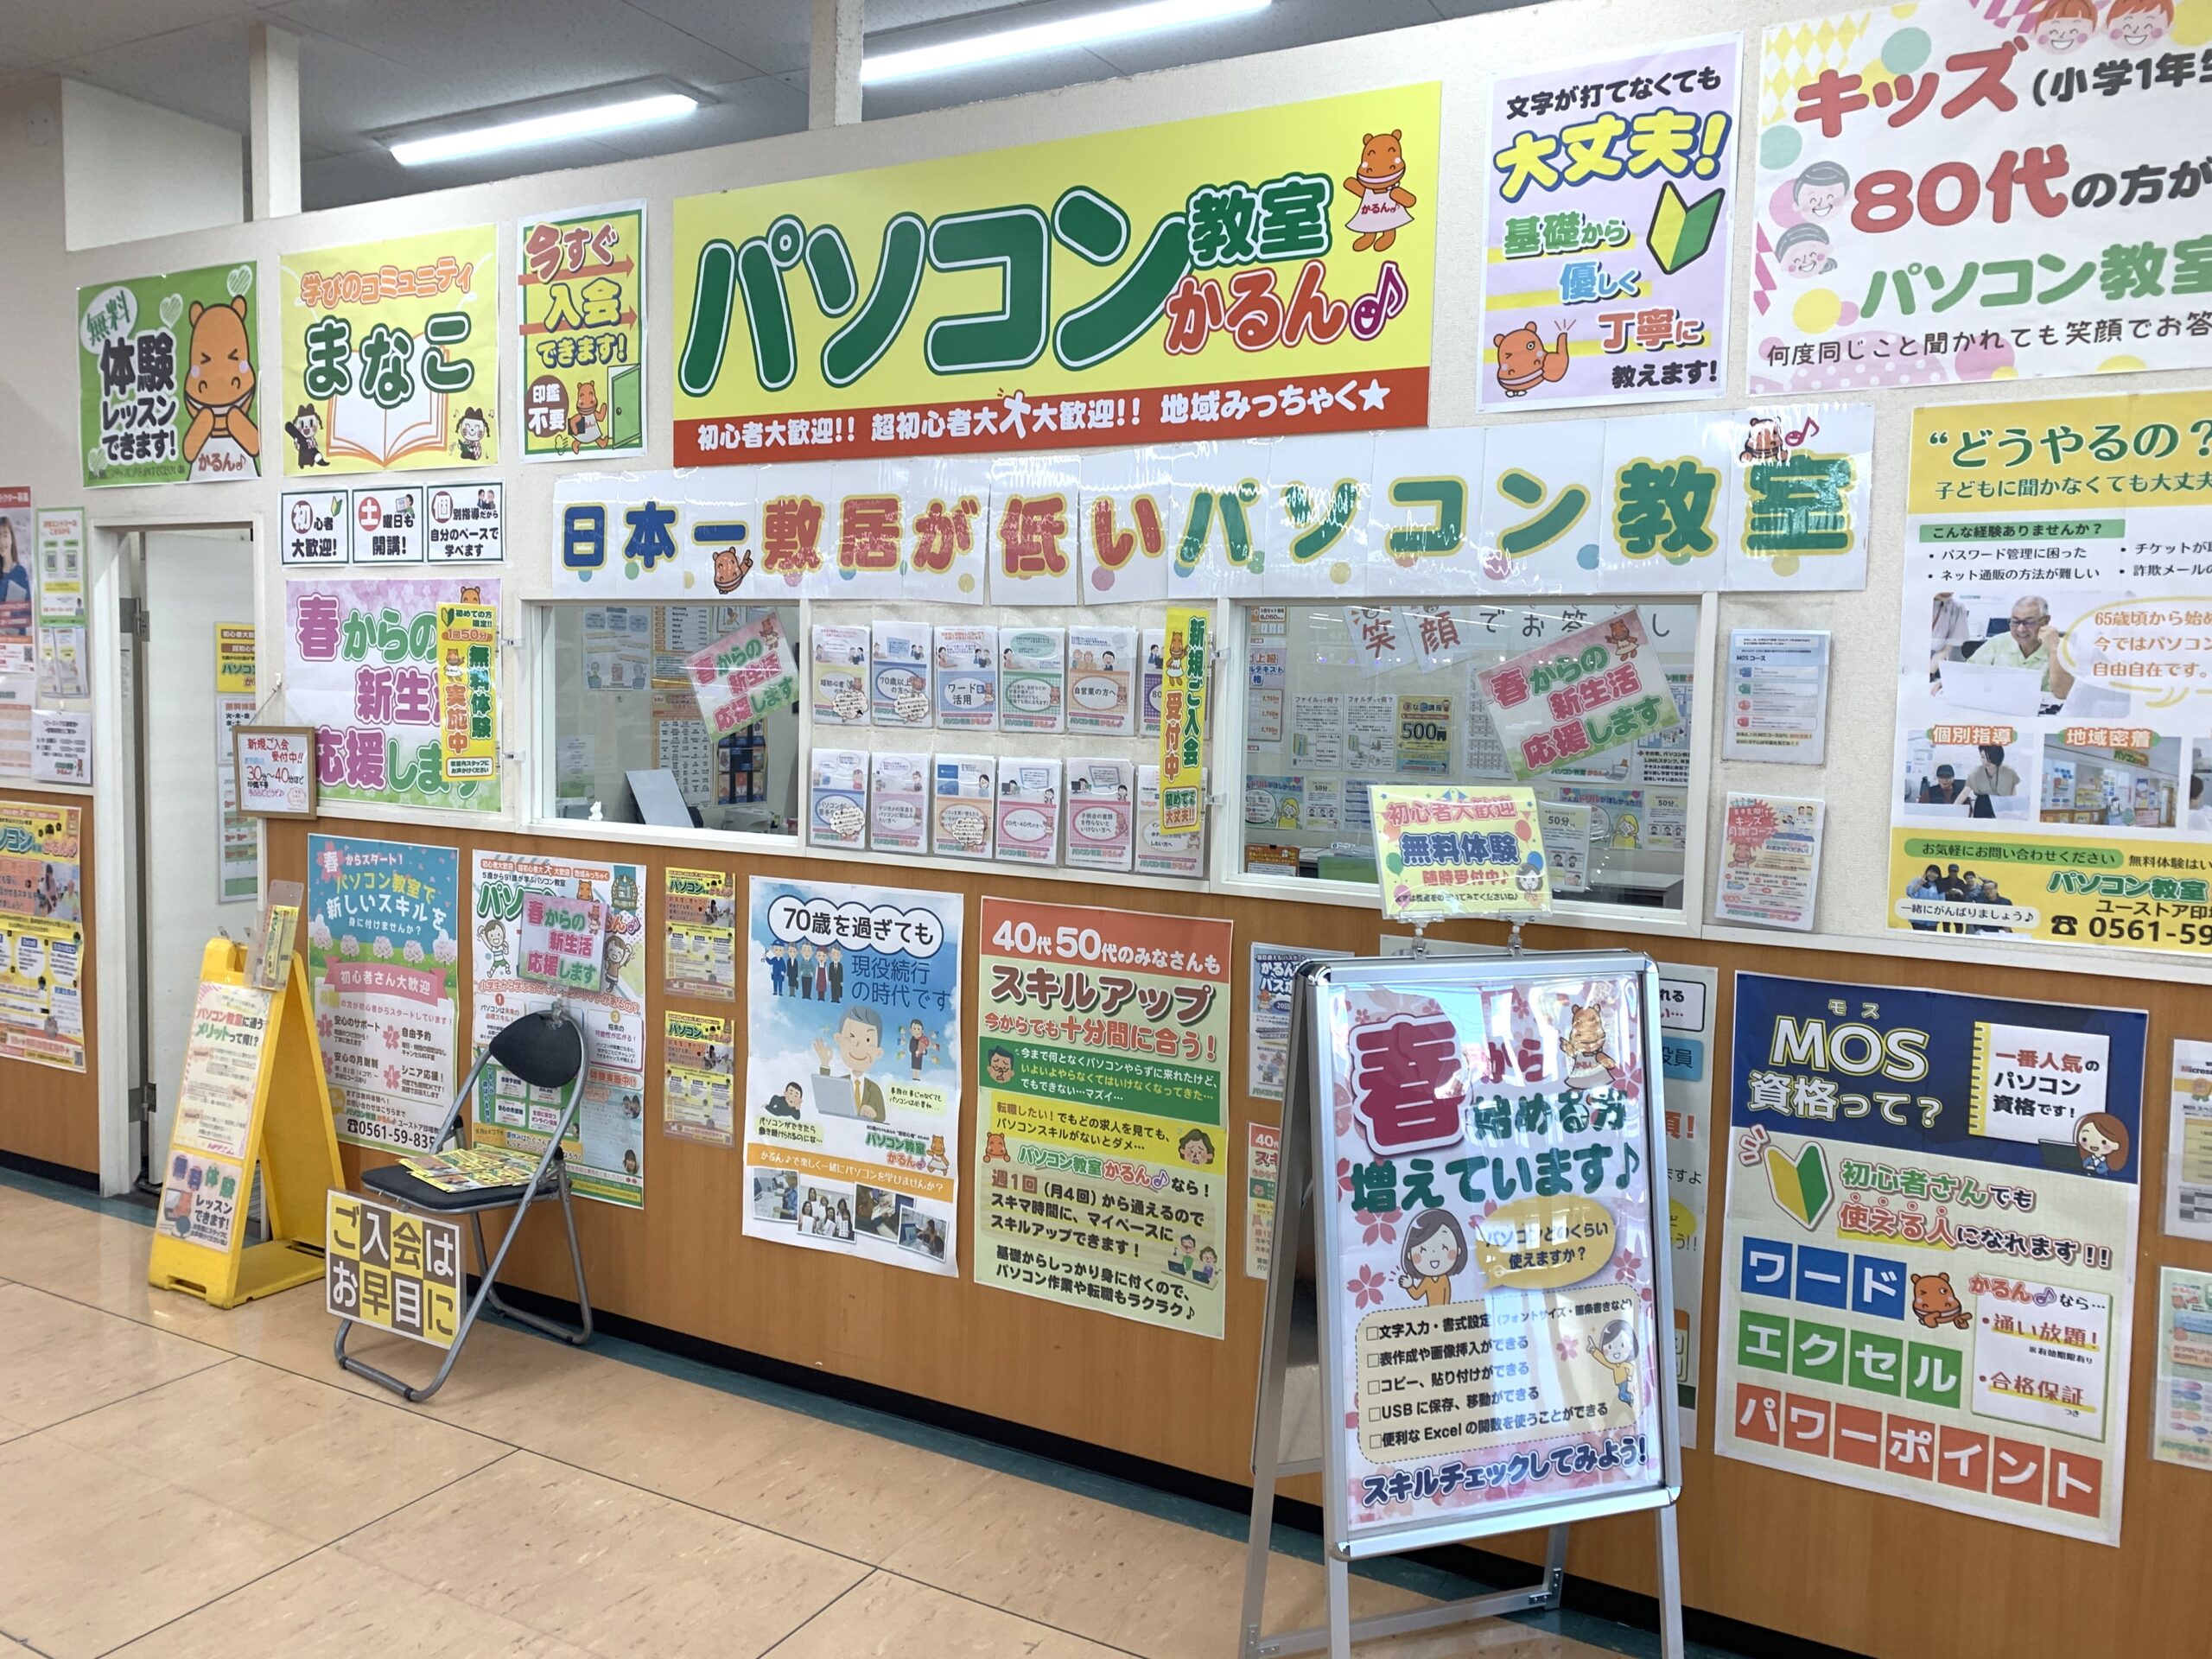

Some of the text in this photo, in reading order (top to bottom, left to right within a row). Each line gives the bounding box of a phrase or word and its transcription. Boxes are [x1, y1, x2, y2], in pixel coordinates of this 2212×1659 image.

[1506, 67, 1722, 120] 文字が打てなくても
[1794, 35, 2030, 137] キッズ
[1494, 106, 1732, 203] 大丈夫!
[1186, 172, 1333, 270] 教室
[1503, 210, 1630, 259] 基礎から
[525, 223, 619, 283] 今すぐ
[301, 257, 474, 308] 学びのコミュニティ
[678, 184, 1192, 398] パソコン
[1560, 261, 1643, 304] 優しく
[1860, 233, 2212, 318] パソコン教室
[87, 290, 130, 346] 無料
[543, 277, 622, 333] 入会
[1598, 308, 1705, 353] 丁寧に
[101, 333, 175, 397] 体験
[304, 313, 474, 409] まなこ
[537, 333, 628, 369] できます!
[1611, 359, 1718, 390] 教えます!
[532, 383, 561, 403] 印鑑
[103, 396, 176, 430] レッスン
[528, 407, 566, 435] 不要
[102, 429, 176, 461] できます!
[698, 416, 855, 452] 初心者大歓迎!!
[292, 503, 334, 531] 初心者
[359, 499, 414, 529] 土曜日も
[434, 493, 499, 521] 個別指導だから
[372, 537, 407, 556] 開講!
[430, 527, 499, 542] 自分のペースで
[1933, 523, 2102, 539] こんな経験ありませんか？
[292, 538, 337, 558] 大歓迎!
[445, 543, 484, 557] 学べます
[1942, 547, 2088, 561] パスワード管理に困った
[1941, 568, 2100, 582] ネット通販の方法が難しい
[455, 609, 493, 619] 初めての方
[447, 629, 488, 641] 1回50分
[694, 638, 764, 685] 春からの
[728, 651, 782, 696] 新生活
[1490, 645, 1610, 709] 春からの
[2094, 661, 2208, 678] 自由自在です。
[948, 683, 976, 693] ワード
[953, 694, 972, 705] 活用
[1074, 686, 1116, 696] 自営業の方へ
[1182, 617, 1207, 768] 新規ご入会
[1548, 663, 1642, 721] 新生活
[444, 683, 469, 755] 実施中
[714, 677, 794, 733] 応援します
[247, 738, 289, 751] 新規ご入会
[1164, 690, 1183, 782] 受付中
[1522, 695, 1663, 770] 応援します
[1933, 725, 2014, 746] 個別指導
[2065, 728, 2152, 748] 地域密着
[1388, 797, 1517, 826] 初心者大歓迎
[1399, 832, 1521, 866] 無料体験
[1922, 842, 2116, 866] お気軽にお問い合わせください
[335, 872, 435, 905] パソコン教室で
[2047, 870, 2209, 903] パソコン教室
[326, 895, 448, 931] 新しいスキルを
[348, 918, 422, 936] 身に付けませんか？
[528, 899, 586, 931] 春からの
[783, 907, 933, 945] 70歳を過ぎても
[549, 930, 594, 957] 新生活
[993, 920, 1220, 975] 40代 50代のみなさんも
[340, 969, 430, 995] 初心者さん大歓迎
[527, 951, 597, 984] 応援します
[851, 955, 930, 984] 現役続行
[851, 982, 950, 1012] の時代です
[990, 964, 1216, 1026] スキルアップ
[1828, 998, 1881, 1019] モス
[334, 1015, 380, 1033] 安心のサポート
[402, 1027, 431, 1042] 自由予約
[984, 1012, 1216, 1061] 今からでも十分間に合う！
[334, 1052, 378, 1069] 安心の月謝制
[1769, 1015, 1930, 1082] MOS
[1996, 1050, 2100, 1073] 一番人気の
[1021, 1047, 1217, 1089] 今まで何となくパソコンやらずに来れたけど、
[1994, 1071, 2081, 1096] パソコン
[1748, 1070, 1942, 1128] 資格って？
[1993, 1094, 2075, 1118] 資格です!
[759, 1117, 816, 1134] パソコンができたら
[865, 1132, 926, 1157] パソコン教室
[1018, 1146, 1104, 1178] パソコン教室
[1840, 1159, 2035, 1211] 初心者さんでも
[196, 1194, 232, 1215] レッスン
[991, 1193, 1174, 1243] スキマ時間に、マイペースに
[334, 1206, 454, 1277] ご入会は
[991, 1214, 1140, 1257] スキルアップできます！
[1837, 1202, 2112, 1268] 使える人になれます!!
[996, 1244, 1190, 1301] 基礎からしっかり身に付くので、
[1509, 1248, 1586, 1269] 使えますか？
[1749, 1249, 1897, 1305] ワード
[333, 1261, 454, 1336] お早目に
[1993, 1313, 2098, 1349] 通い放題！
[1379, 1335, 1529, 1367] 表作成や画像挿入ができる
[1745, 1323, 1957, 1394] エクセル
[1380, 1362, 1529, 1393] コピー、貼り付けができる
[1991, 1370, 2084, 1407] 合格保証
[1382, 1387, 1540, 1420] USB に保存、移動ができる
[2064, 1408, 2080, 1418] つき
[1382, 1402, 1609, 1448] 便利な Excel の関数を使うことができる
[1739, 1396, 2093, 1499] パワーポイント
[1361, 1434, 1648, 1508] スキルチェックしてみよう!
